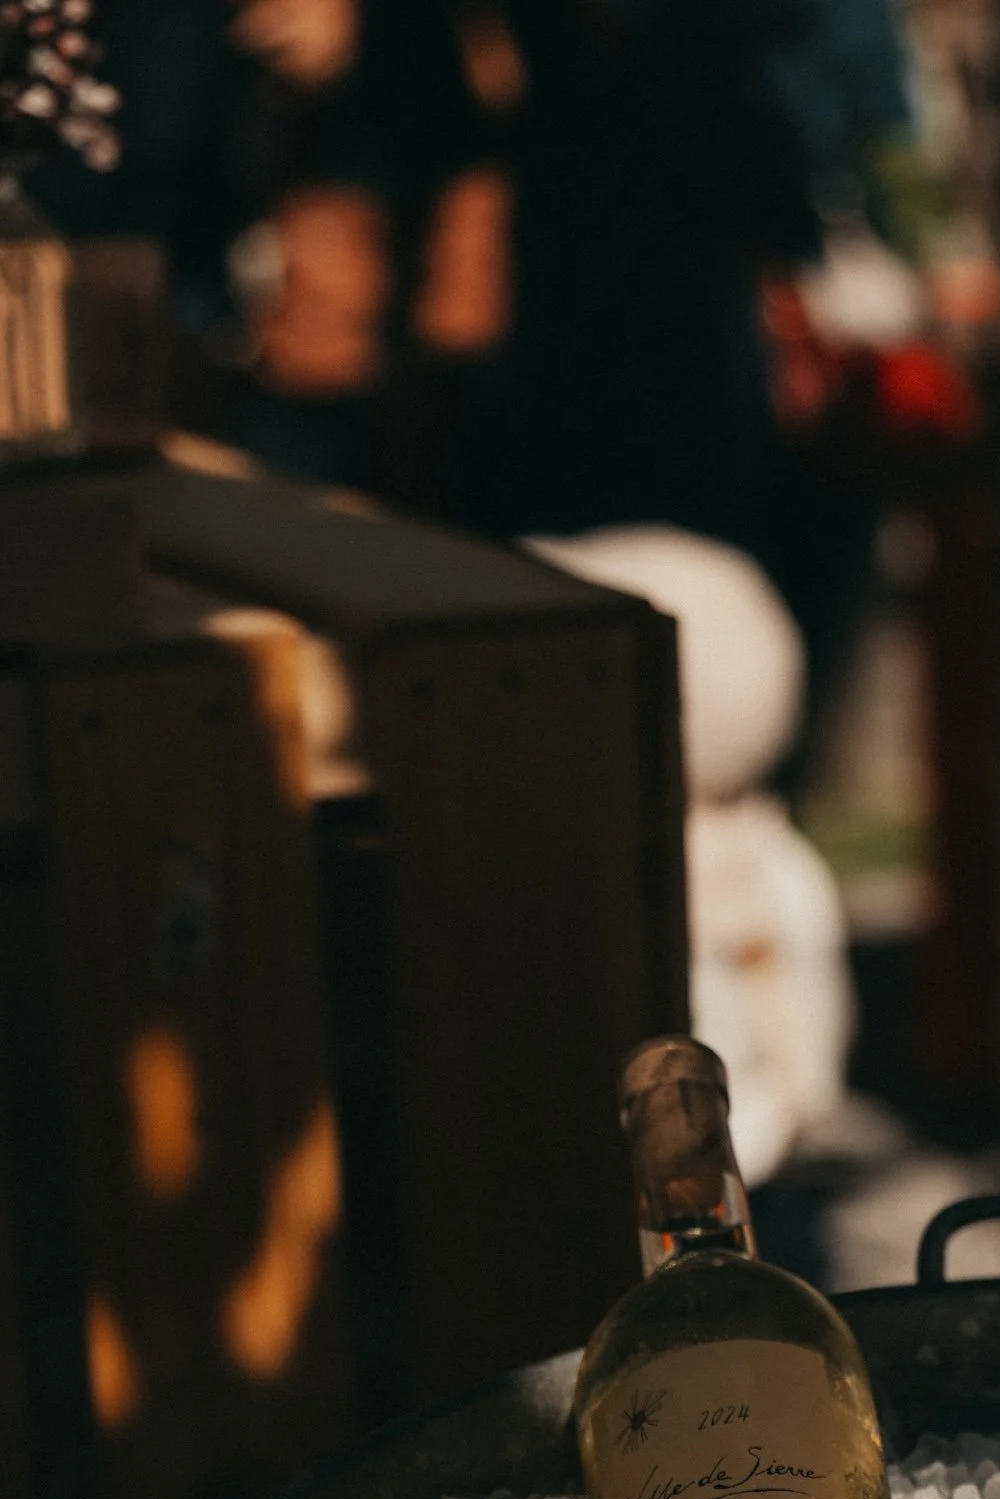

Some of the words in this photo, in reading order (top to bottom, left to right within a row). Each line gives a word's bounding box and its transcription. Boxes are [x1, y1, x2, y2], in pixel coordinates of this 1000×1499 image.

[697, 1404, 750, 1432] 2024
[697, 1456, 732, 1487] de
[713, 1446, 826, 1489] Sierre
